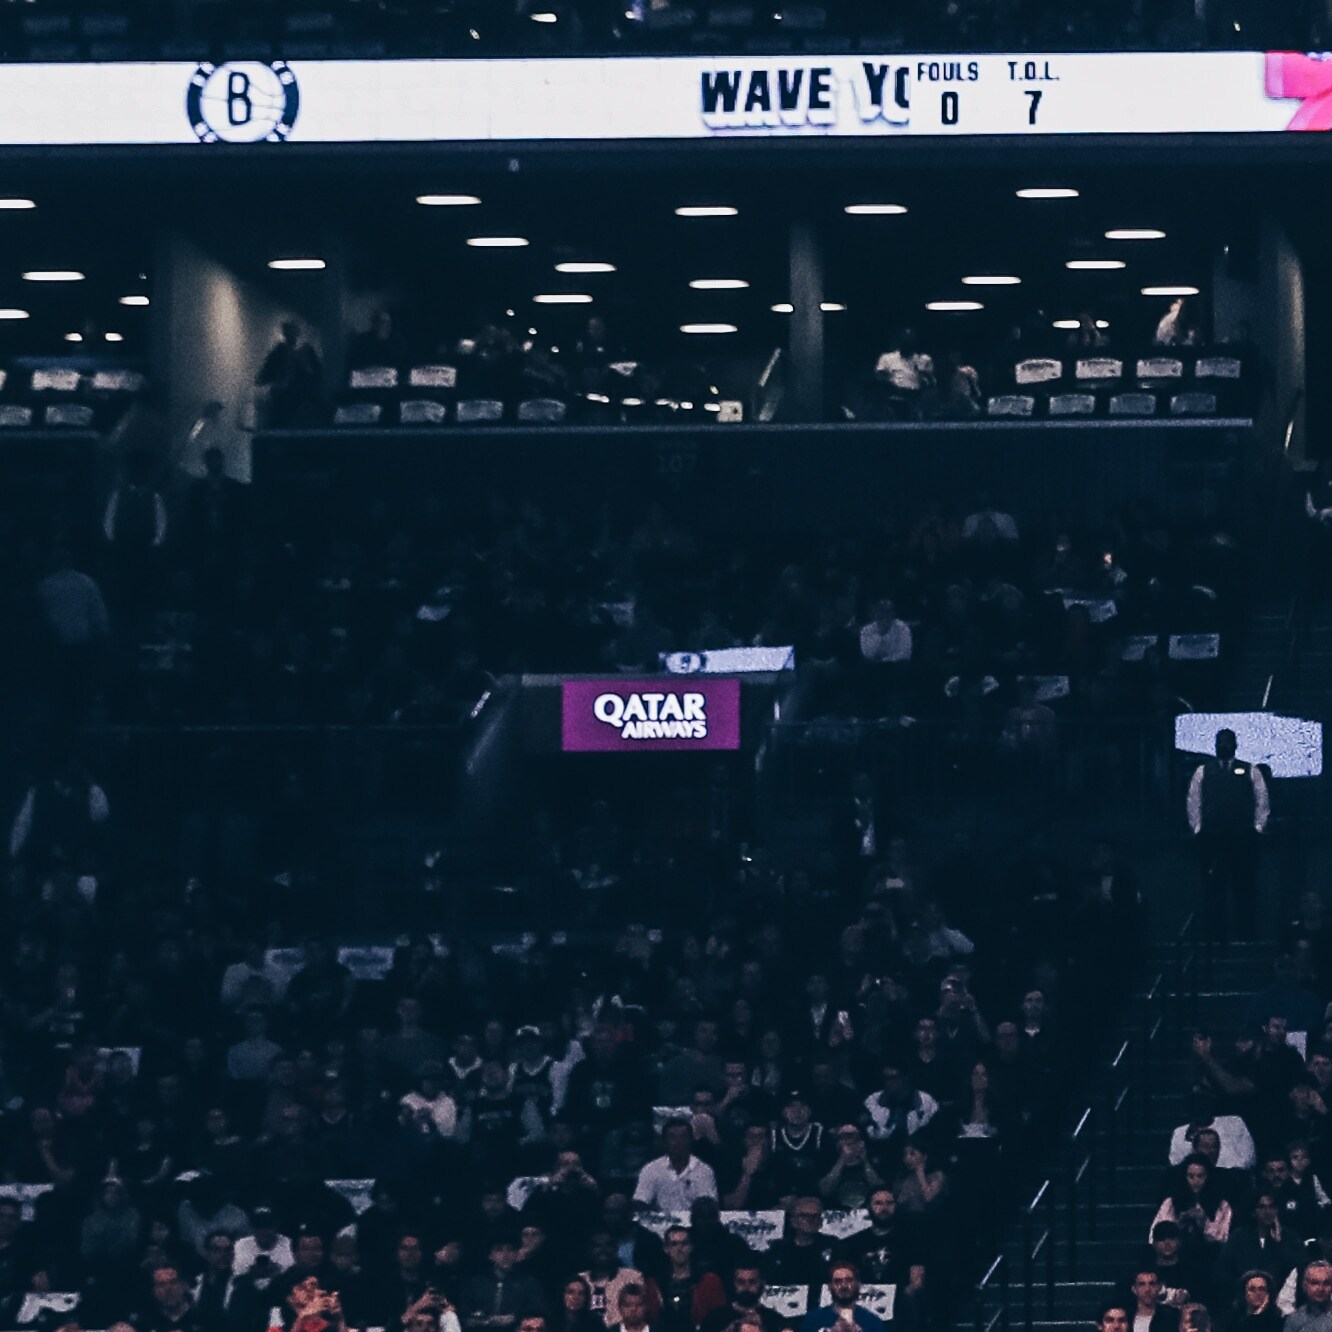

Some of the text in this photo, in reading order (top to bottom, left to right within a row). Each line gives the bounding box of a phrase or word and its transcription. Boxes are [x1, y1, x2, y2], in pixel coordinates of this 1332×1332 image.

[917, 62, 979, 82] FOULS
[1007, 61, 1060, 82] T.O.L.
[702, 67, 832, 112] WAVE
[941, 91, 958, 125] 0
[1023, 90, 1042, 125] 7
[593, 692, 706, 725] QATAR
[621, 719, 707, 741] AIRWAYS
